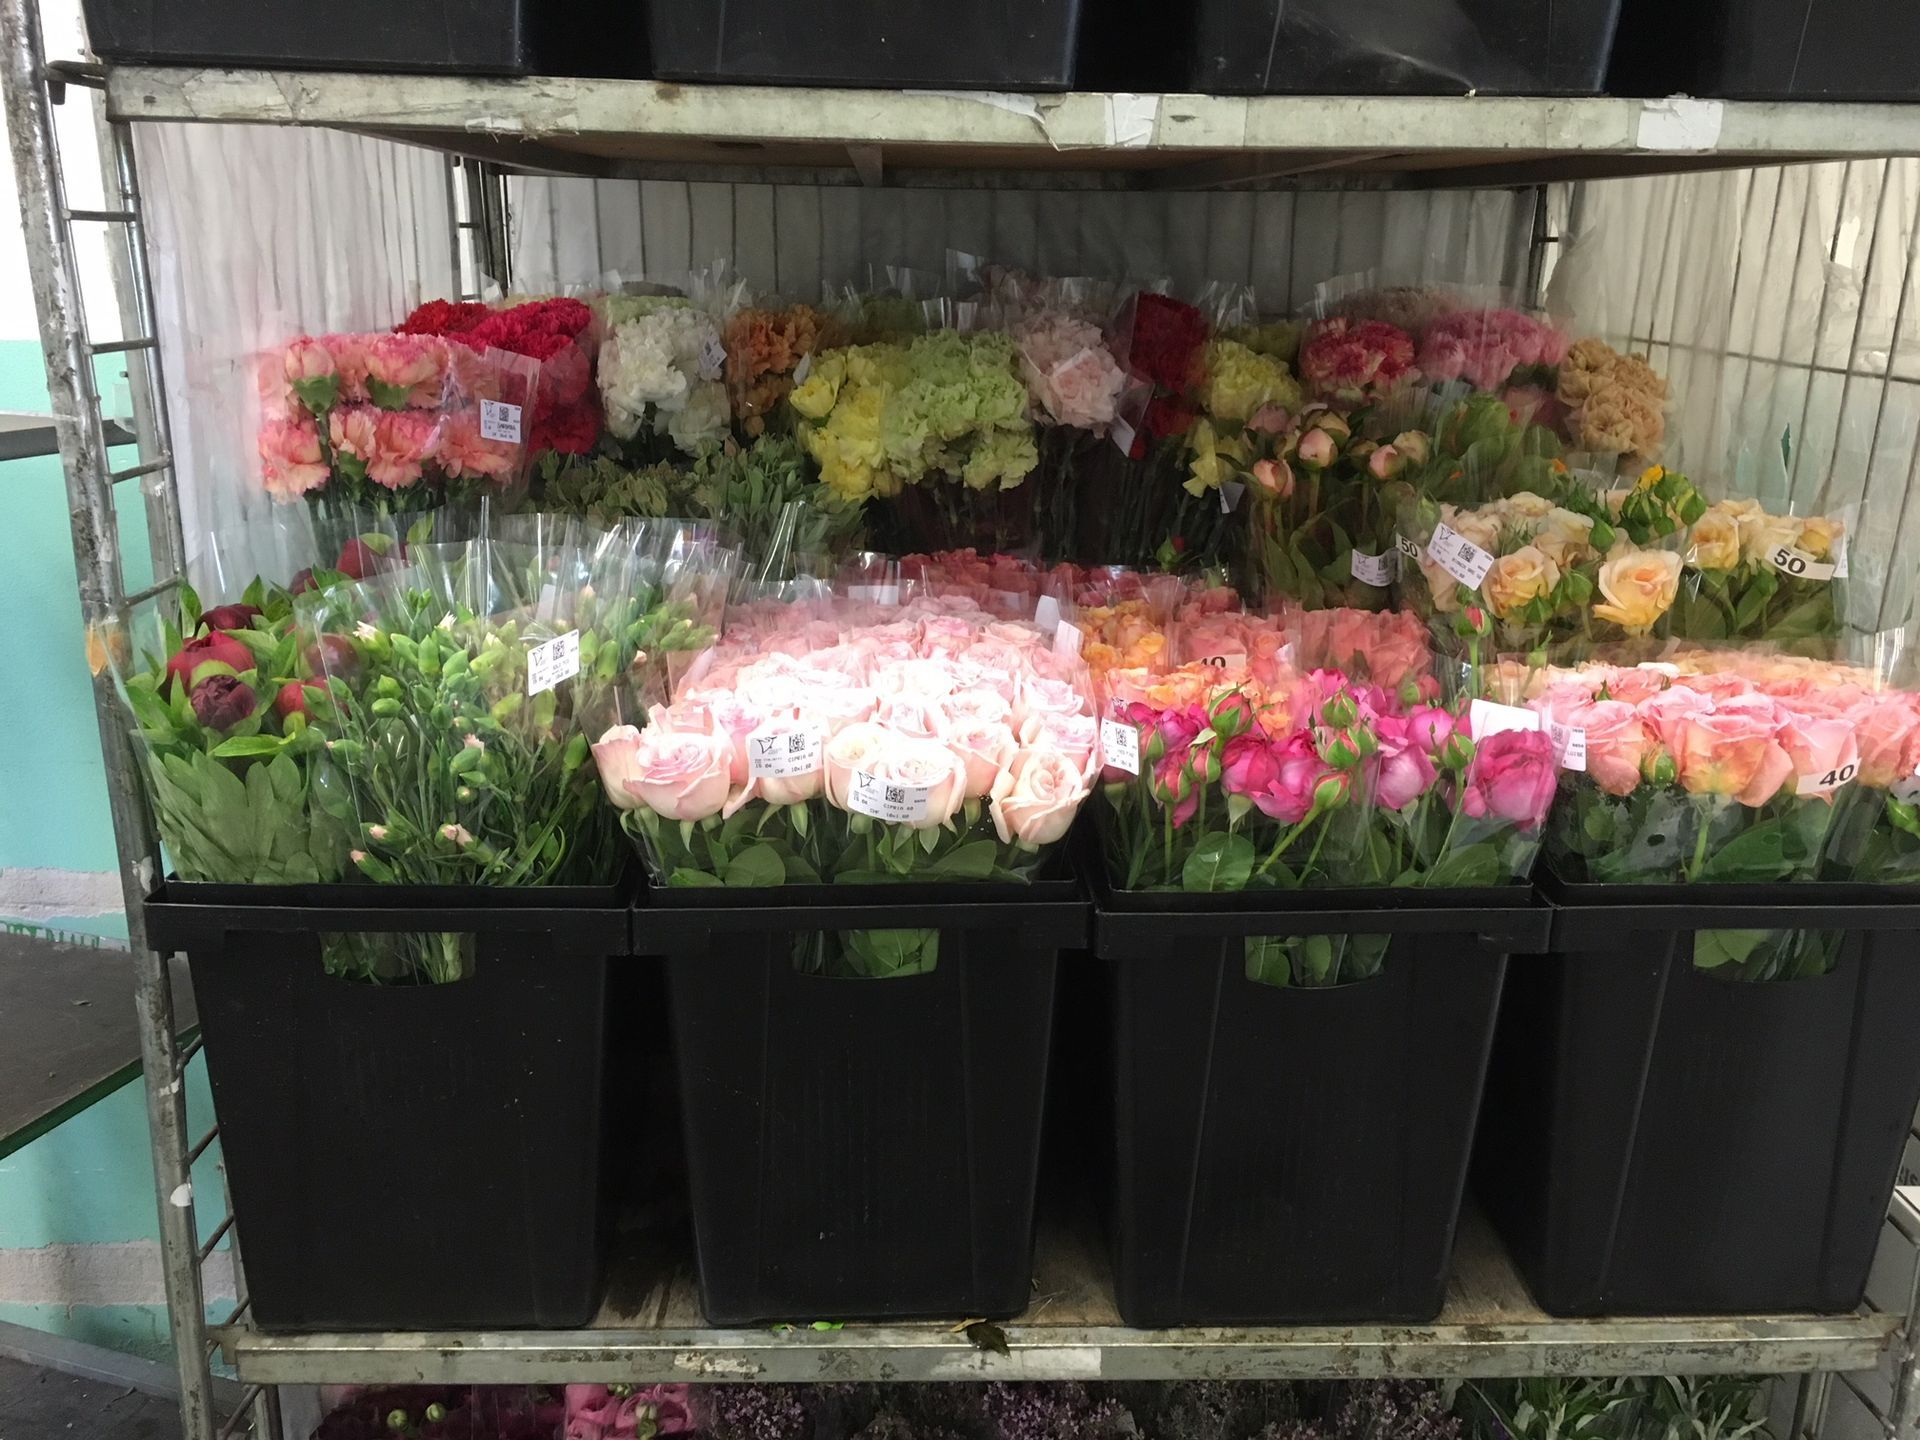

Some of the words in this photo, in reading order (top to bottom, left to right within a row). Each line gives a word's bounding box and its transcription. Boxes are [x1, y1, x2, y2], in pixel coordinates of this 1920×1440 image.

[1401, 538, 1418, 557] 50
[1774, 548, 1806, 574] 50
[1819, 764, 1855, 786] 40
